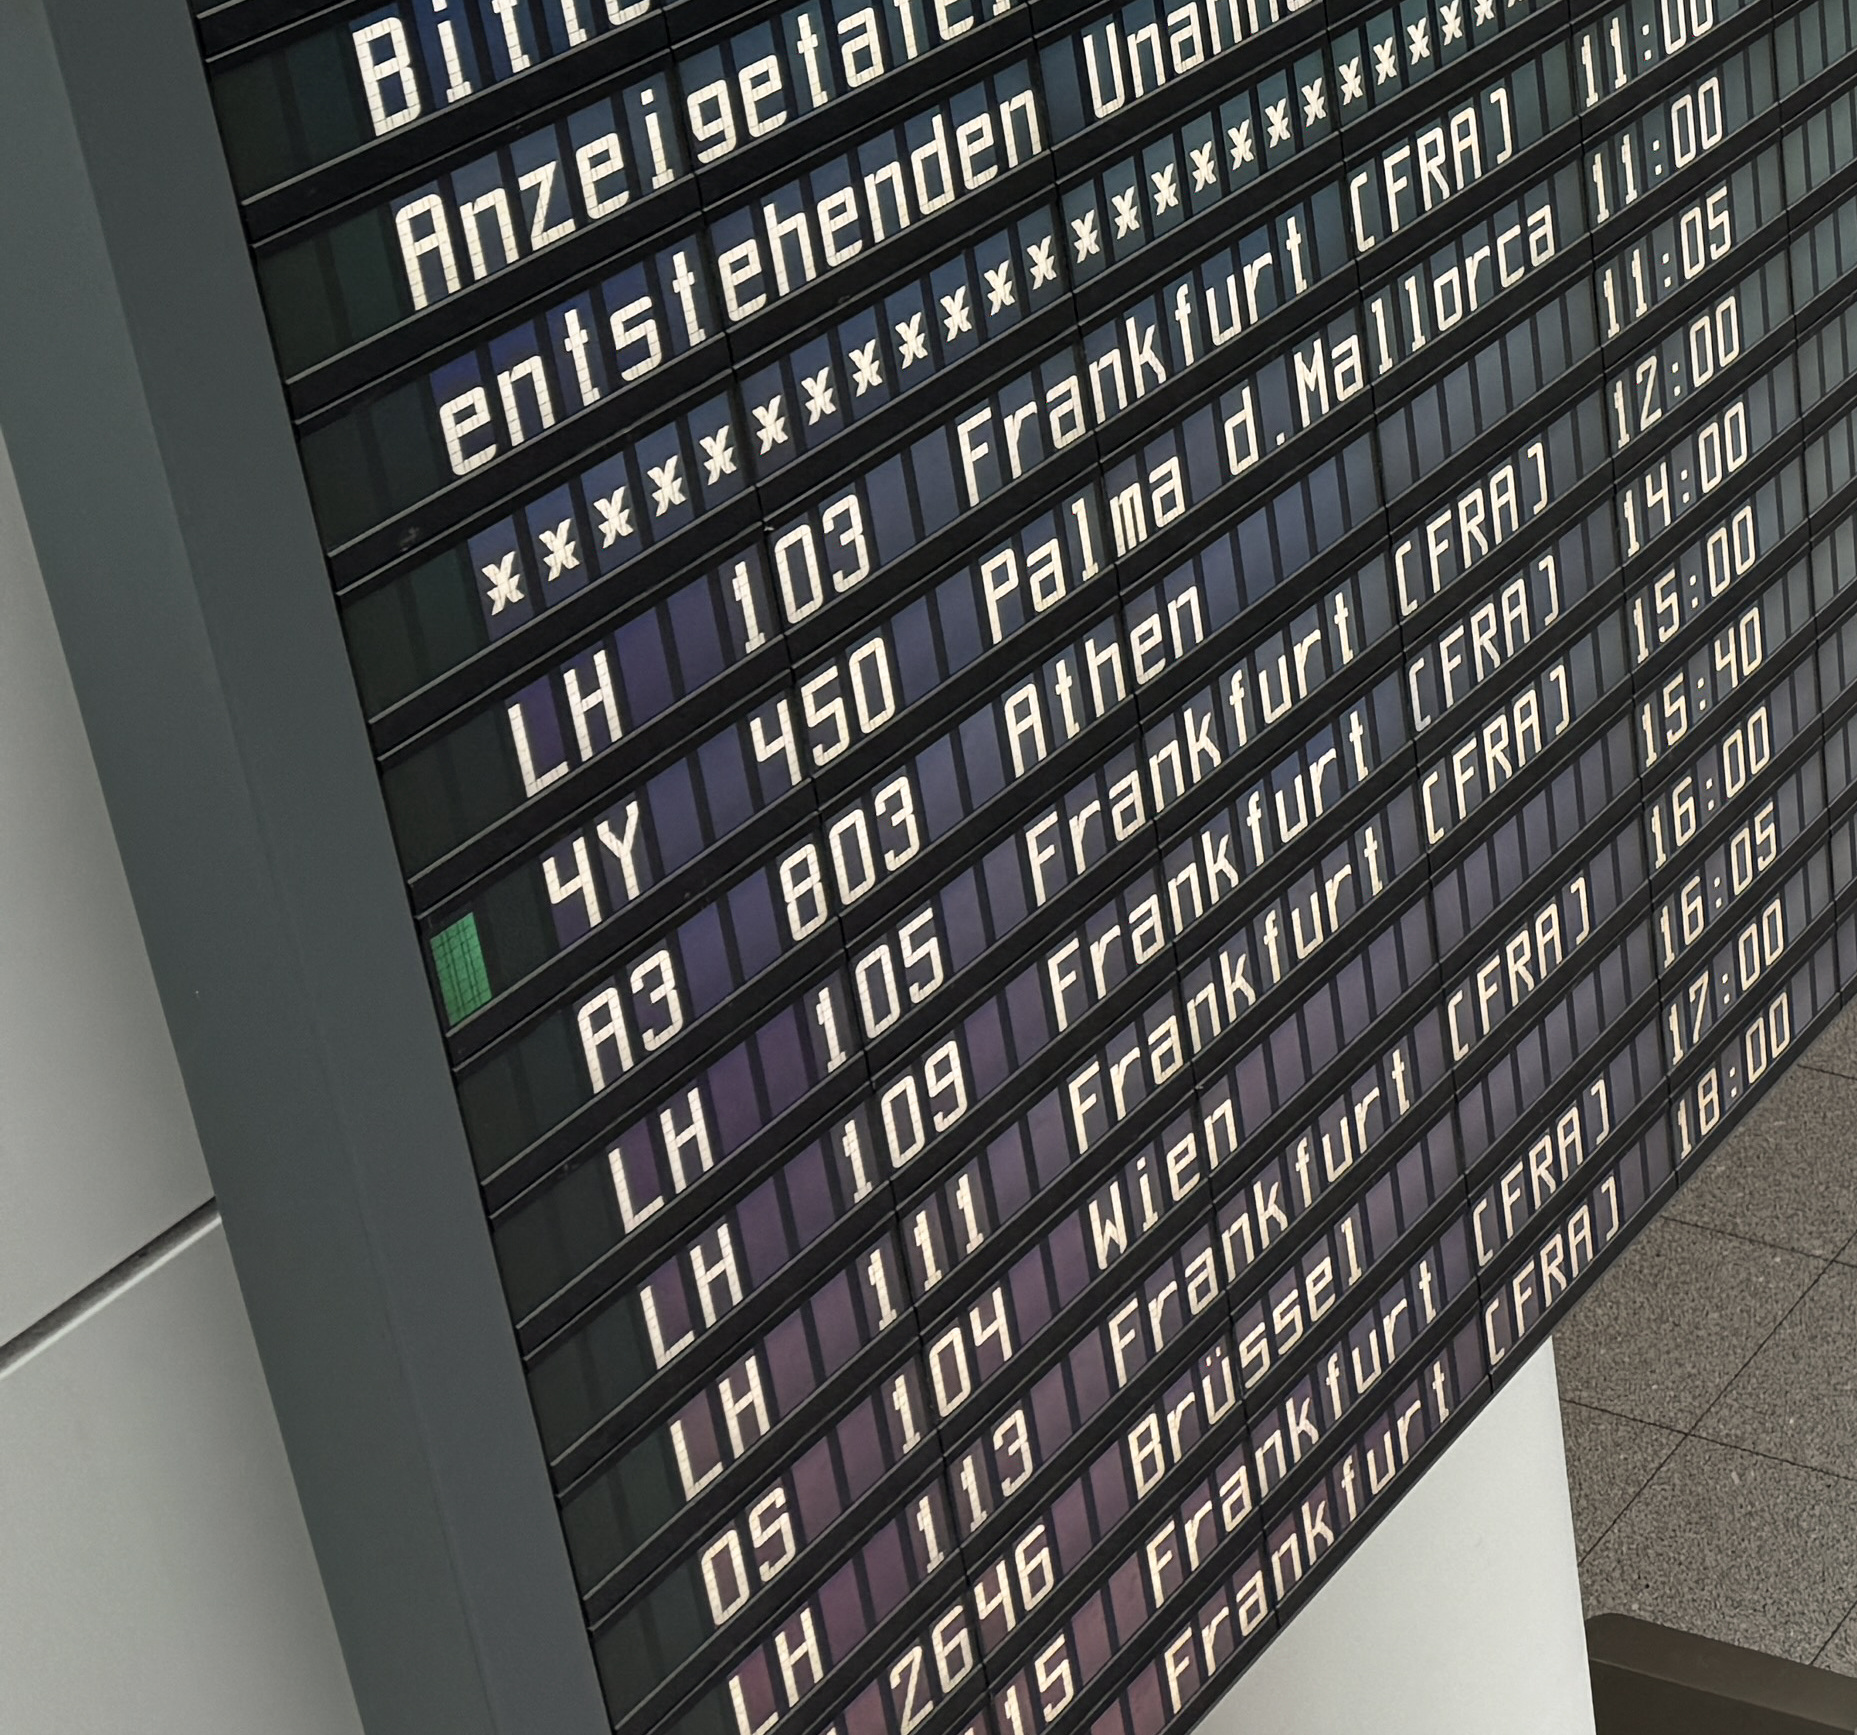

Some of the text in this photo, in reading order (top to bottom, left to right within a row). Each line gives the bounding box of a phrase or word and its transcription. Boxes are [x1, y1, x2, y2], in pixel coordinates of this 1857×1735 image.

[439, 89, 1041, 475] entstehenden
[508, 650, 622, 797] LH
[732, 494, 869, 653] 103
[957, 216, 1307, 506] Frankfurt
[542, 800, 639, 927] 4Y
[750, 637, 895, 785] 450
[981, 456, 1185, 643] Palma
[1592, 76, 1722, 223] 11:00
[577, 950, 682, 1093] A3
[779, 776, 919, 940] 803
[1004, 586, 1203, 777] Athen
[1603, 185, 1730, 338] 11:05
[608, 1087, 713, 1232] LH
[816, 907, 943, 1072] 105
[1025, 592, 1353, 906] Frankfurt
[1613, 295, 1739, 448] 12:00
[842, 401, 1747, 1202] 109 Frankfurt 14:00
[867, 505, 1755, 1330] 111 Frankfurt 15:00
[892, 607, 1762, 1453] 104 Wien 15:40
[1677, 992, 1789, 1159] 18:00
[890, 1217, 1361, 1734] 2646 Brüssel
